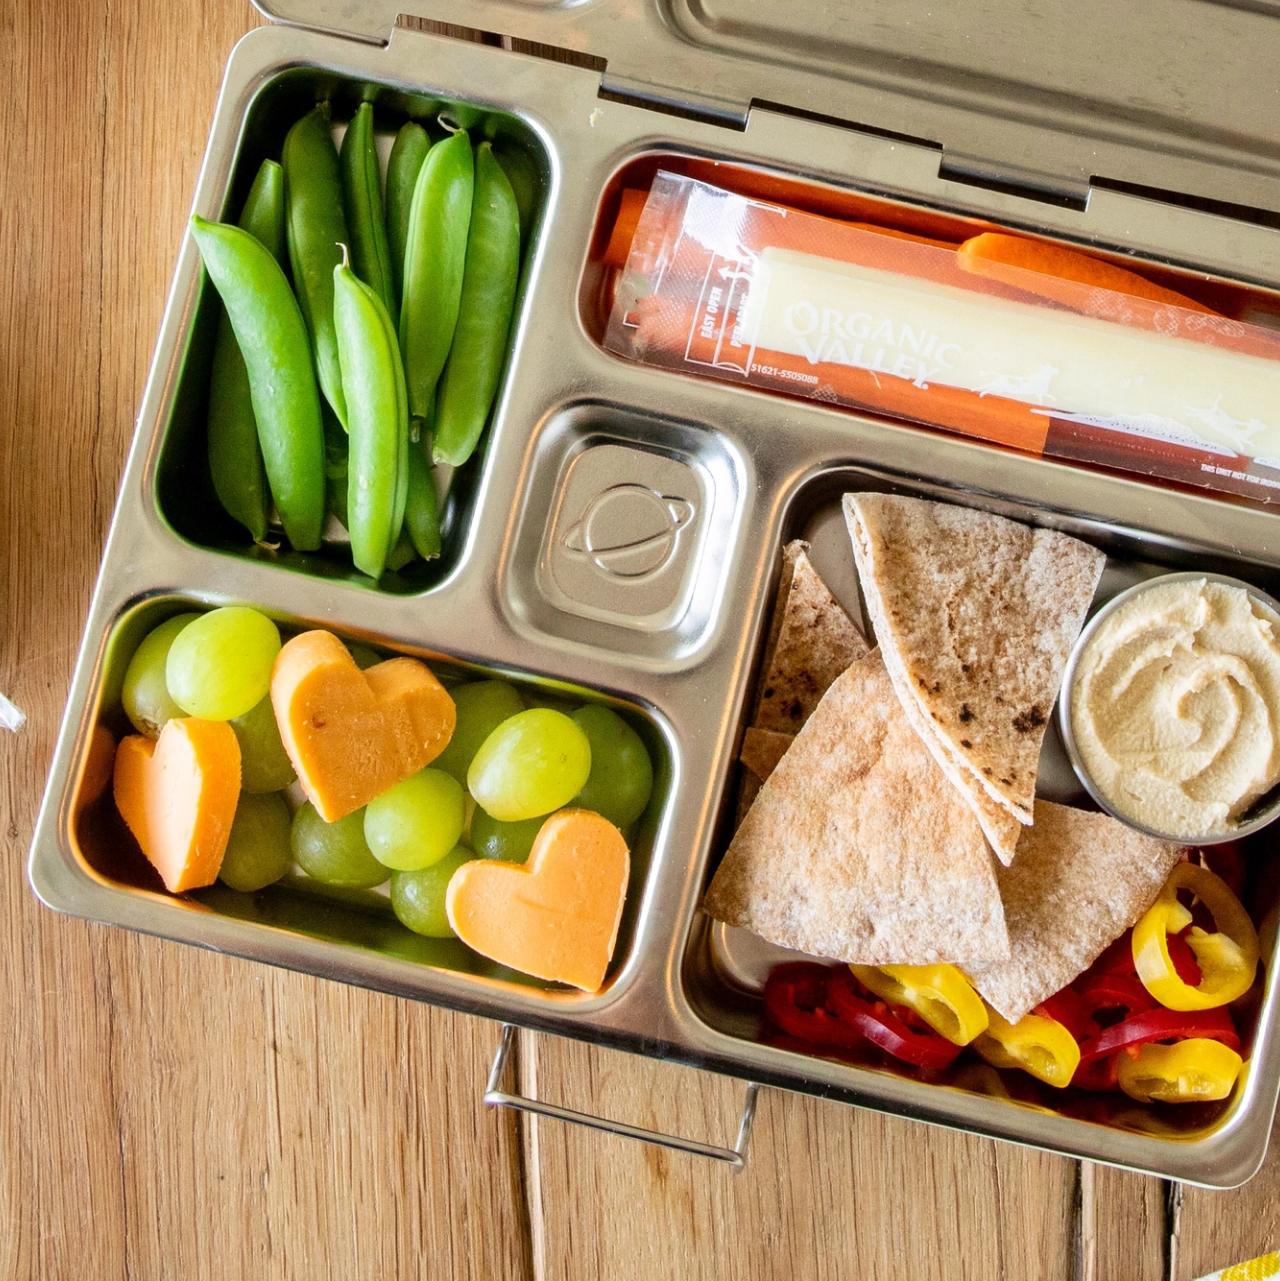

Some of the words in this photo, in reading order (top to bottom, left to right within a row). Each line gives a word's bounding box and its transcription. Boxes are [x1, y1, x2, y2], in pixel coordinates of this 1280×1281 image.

[705, 286, 723, 314] OPEN
[700, 313, 716, 338] EASY
[786, 300, 961, 367] ORGANIC
[1200, 463, 1216, 473] THIS
[1215, 466, 1232, 477] UNIT
[1231, 470, 1246, 480] NOT
[1245, 474, 1259, 484] FOR
